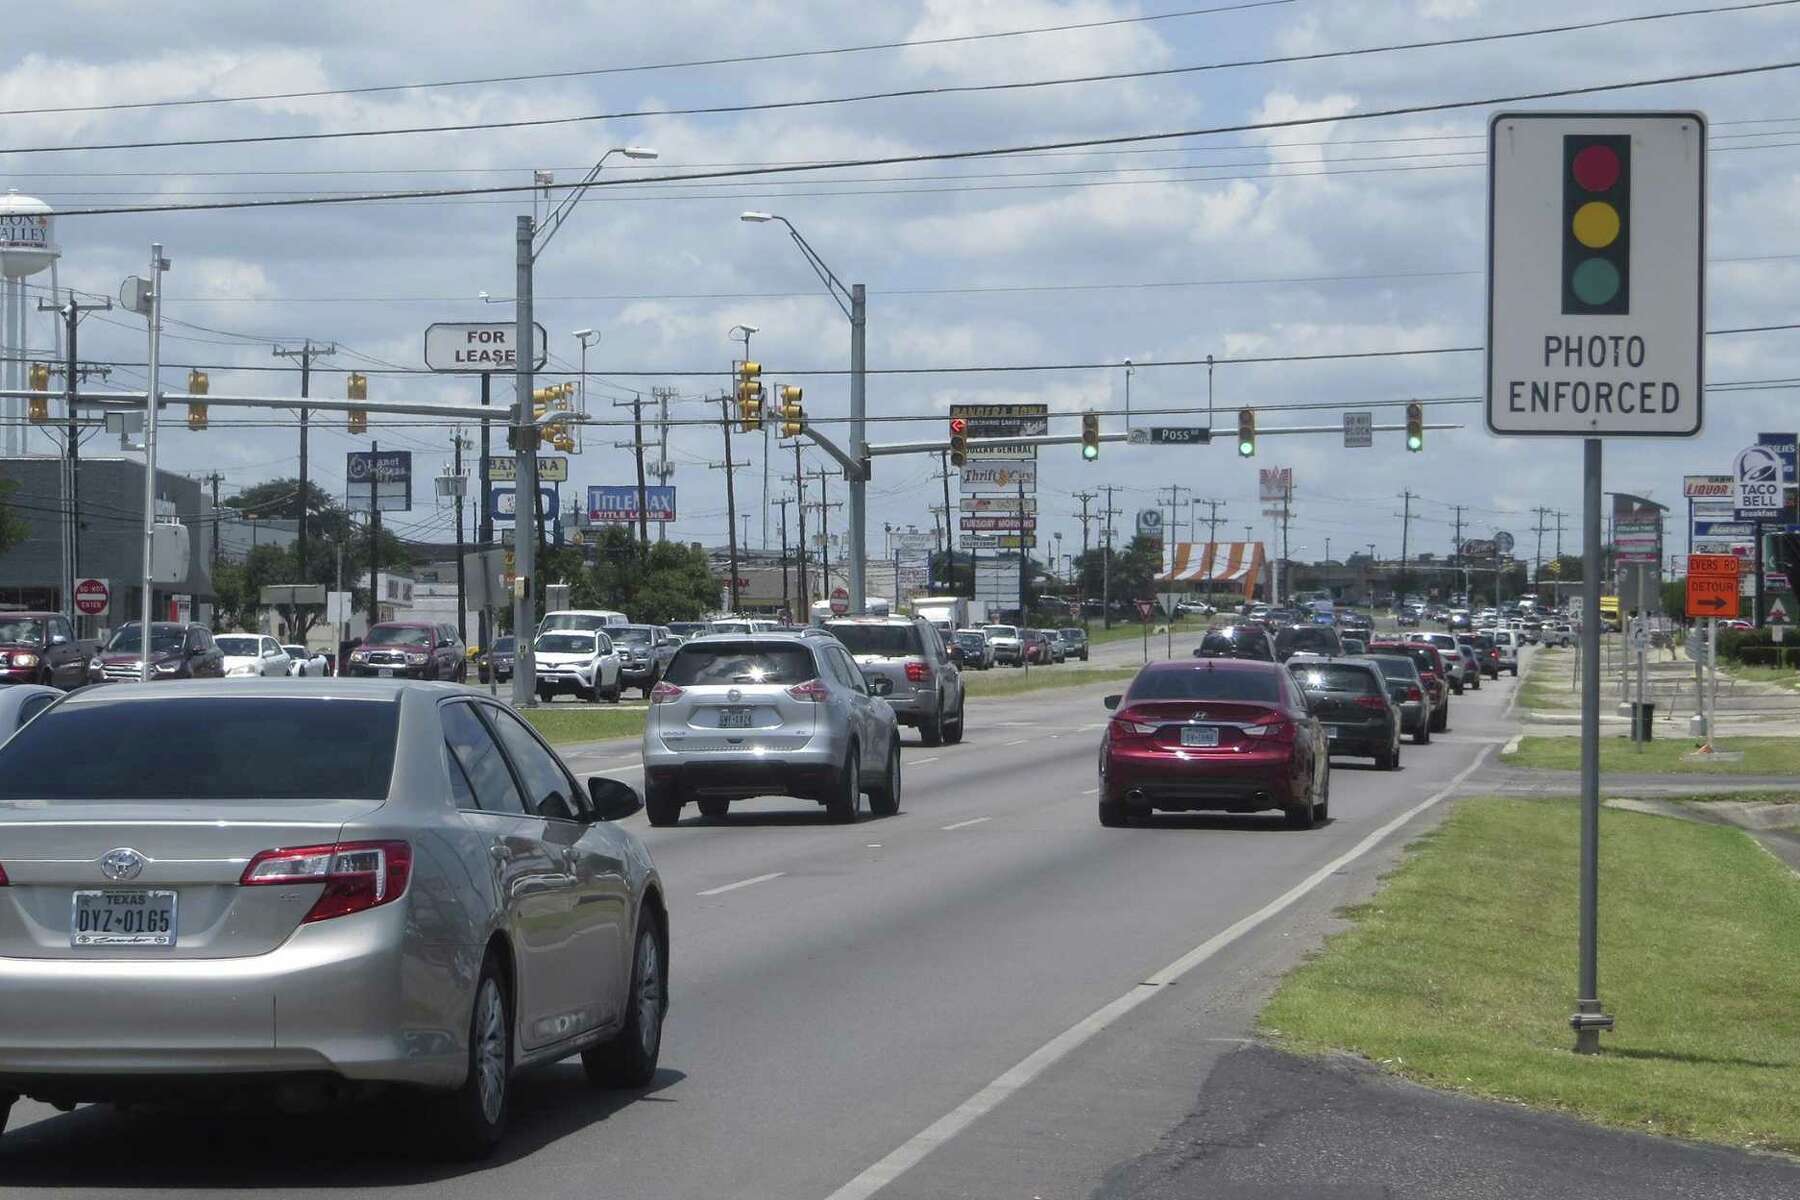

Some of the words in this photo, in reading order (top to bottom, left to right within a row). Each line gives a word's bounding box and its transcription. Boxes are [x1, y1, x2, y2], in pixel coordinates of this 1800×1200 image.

[0, 226, 48, 241] ALLEY
[467, 330, 506, 344] FOR
[455, 349, 516, 363] LEASE
[1544, 335, 1646, 368] PHOTO
[1509, 381, 1681, 414] ENFORCED
[489, 459, 559, 470] BANRA
[1687, 485, 1728, 495] LIQUOR
[1741, 484, 1777, 495] TACO
[1743, 497, 1776, 506] BELL
[998, 520, 1034, 529] MORNNG
[1691, 559, 1718, 570] EVERS
[1724, 559, 1736, 570] RD
[1692, 582, 1734, 592] DETOUR
[106, 895, 146, 904] TEXAS
